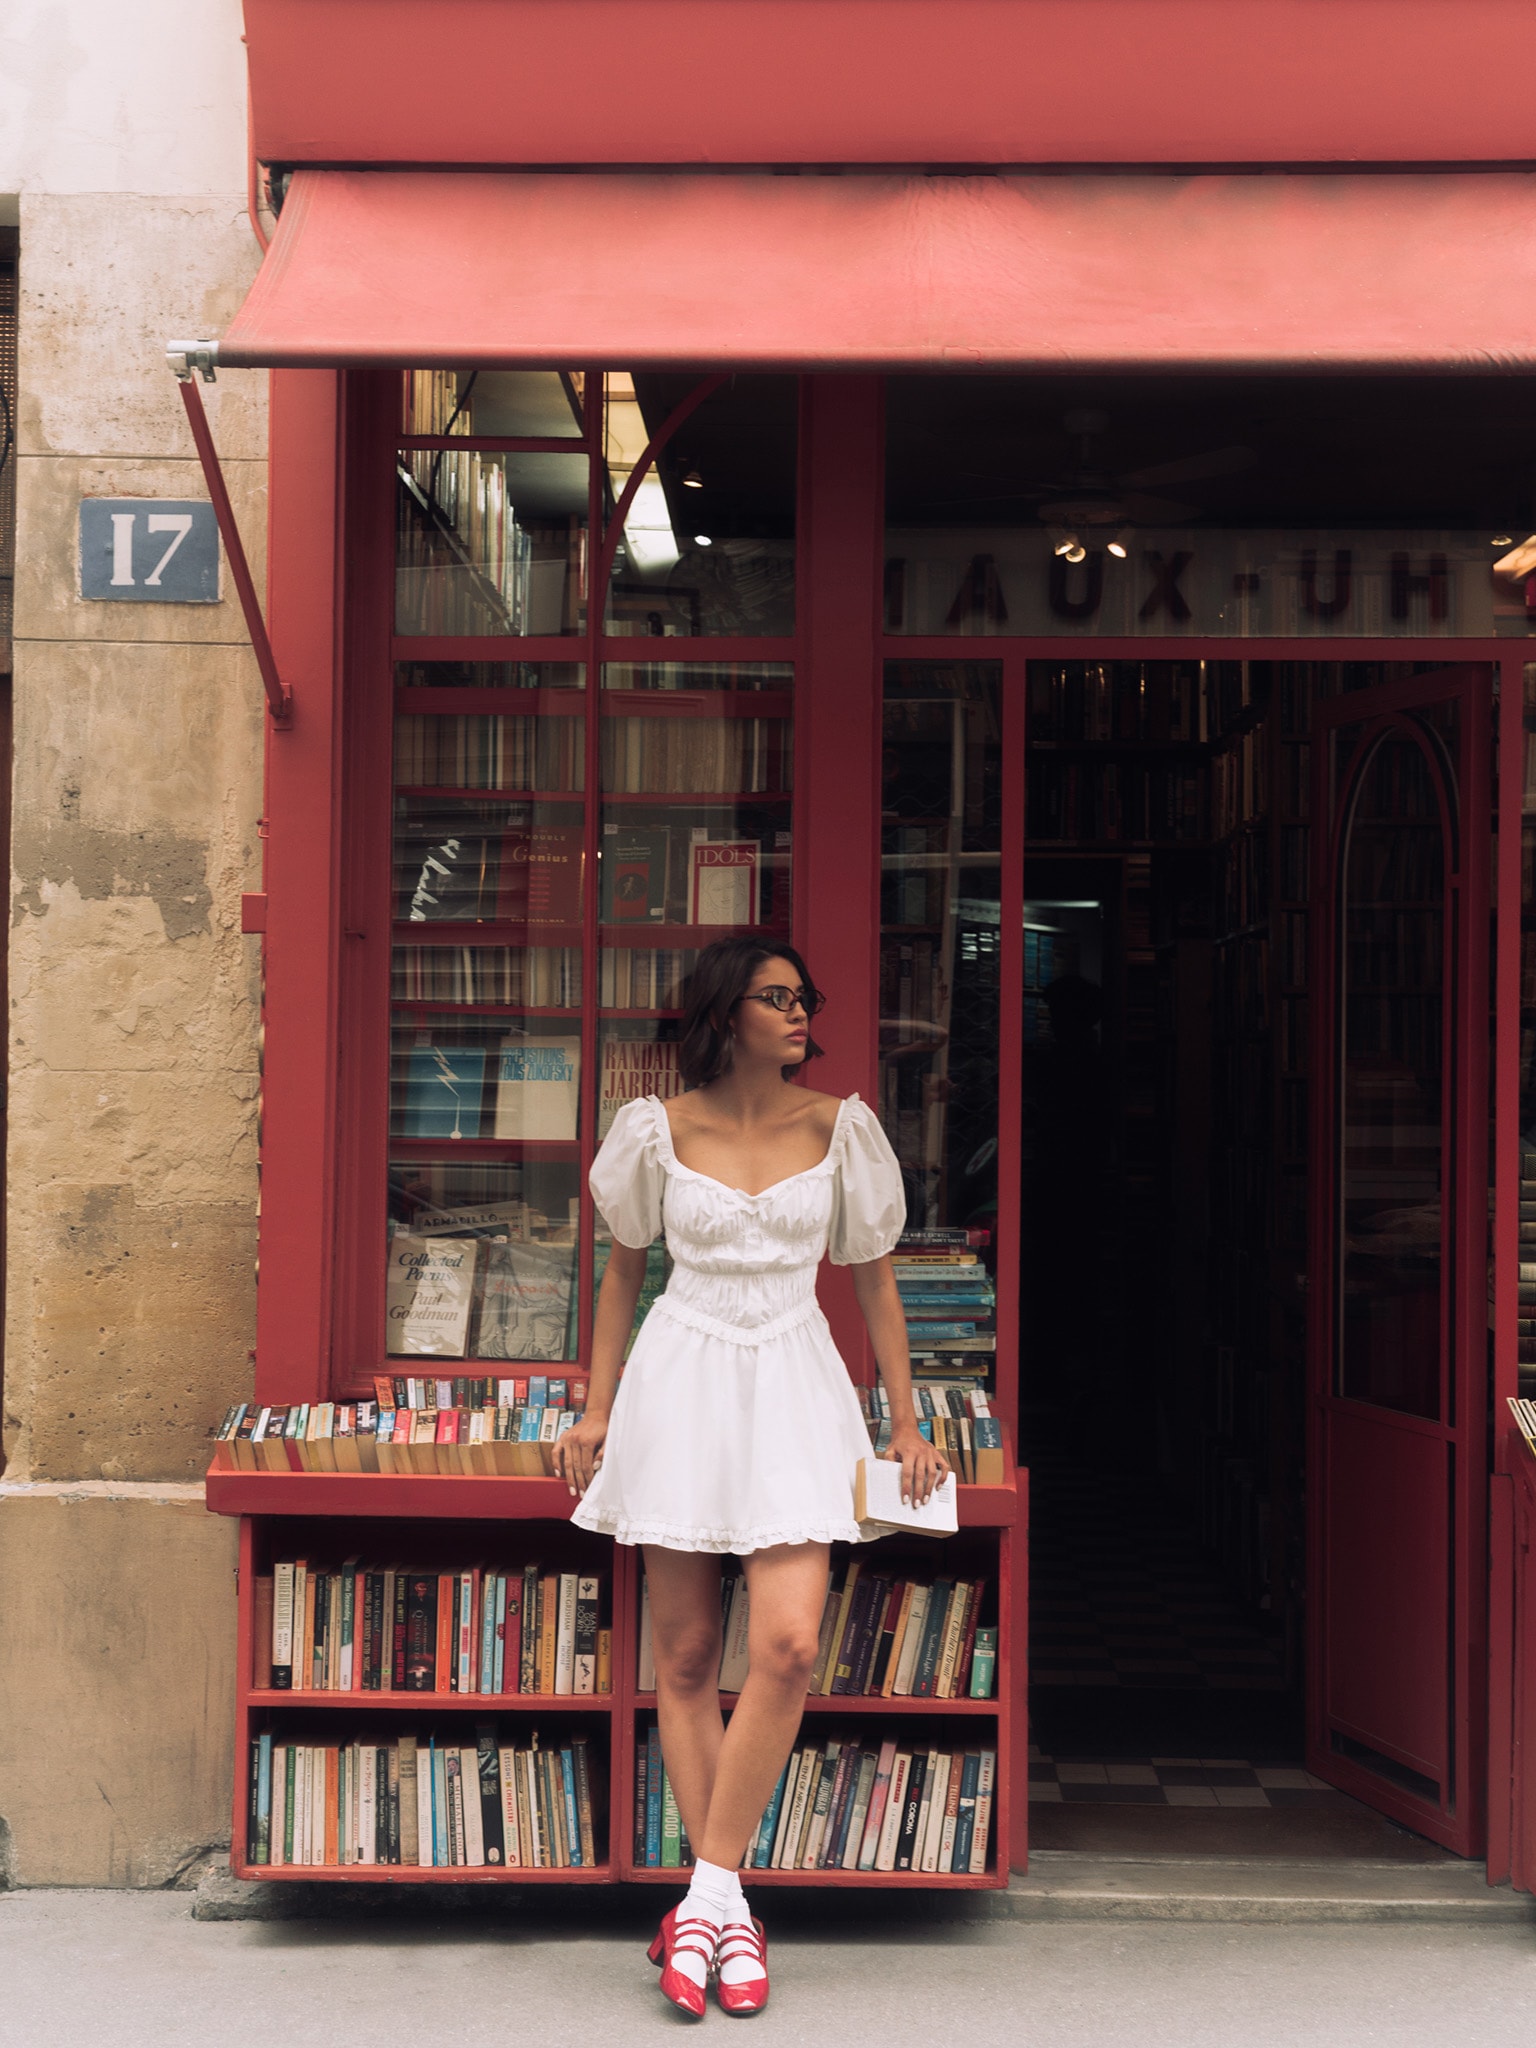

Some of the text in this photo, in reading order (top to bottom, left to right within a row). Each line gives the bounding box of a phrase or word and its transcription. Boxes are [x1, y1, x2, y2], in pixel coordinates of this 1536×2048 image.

[110, 513, 193, 586] 17
[513, 845, 568, 863] Genius
[697, 849, 756, 864] IDOLS
[424, 1213, 498, 1227] ARMADILLO
[399, 1252, 466, 1268] Collected
[405, 1267, 453, 1281] Poems
[410, 1292, 444, 1306] Paul
[390, 1305, 459, 1321] Goodman
[396, 1577, 405, 1600] PATRICK
[871, 1581, 881, 1604] DOROTHY
[342, 1592, 351, 1621] Descending
[563, 1579, 573, 1631] JOHN GRISHAM
[577, 1605, 585, 1633] DOWN
[583, 1612, 591, 1637] GONE
[412, 1609, 424, 1661] QUICKSILVER
[947, 1620, 961, 1653] Charlotte
[922, 1632, 937, 1676] Northern Lights
[983, 1757, 991, 1768] THE
[504, 1752, 514, 1824] LESSONS CHEMISTRY
[649, 1768, 659, 1793] DYER
[982, 1769, 990, 1782] MAN
[793, 1764, 810, 1820] TENT OF MIRACLES
[815, 1781, 831, 1811] DUNBAR
[388, 1809, 396, 1831] Chemistry
[455, 1785, 464, 1857] MICHAEL FOOT
[905, 1788, 919, 1835] RED CORONA
[946, 1784, 958, 1840] TELLING TALES
[979, 1801, 987, 1824] BEIJING
